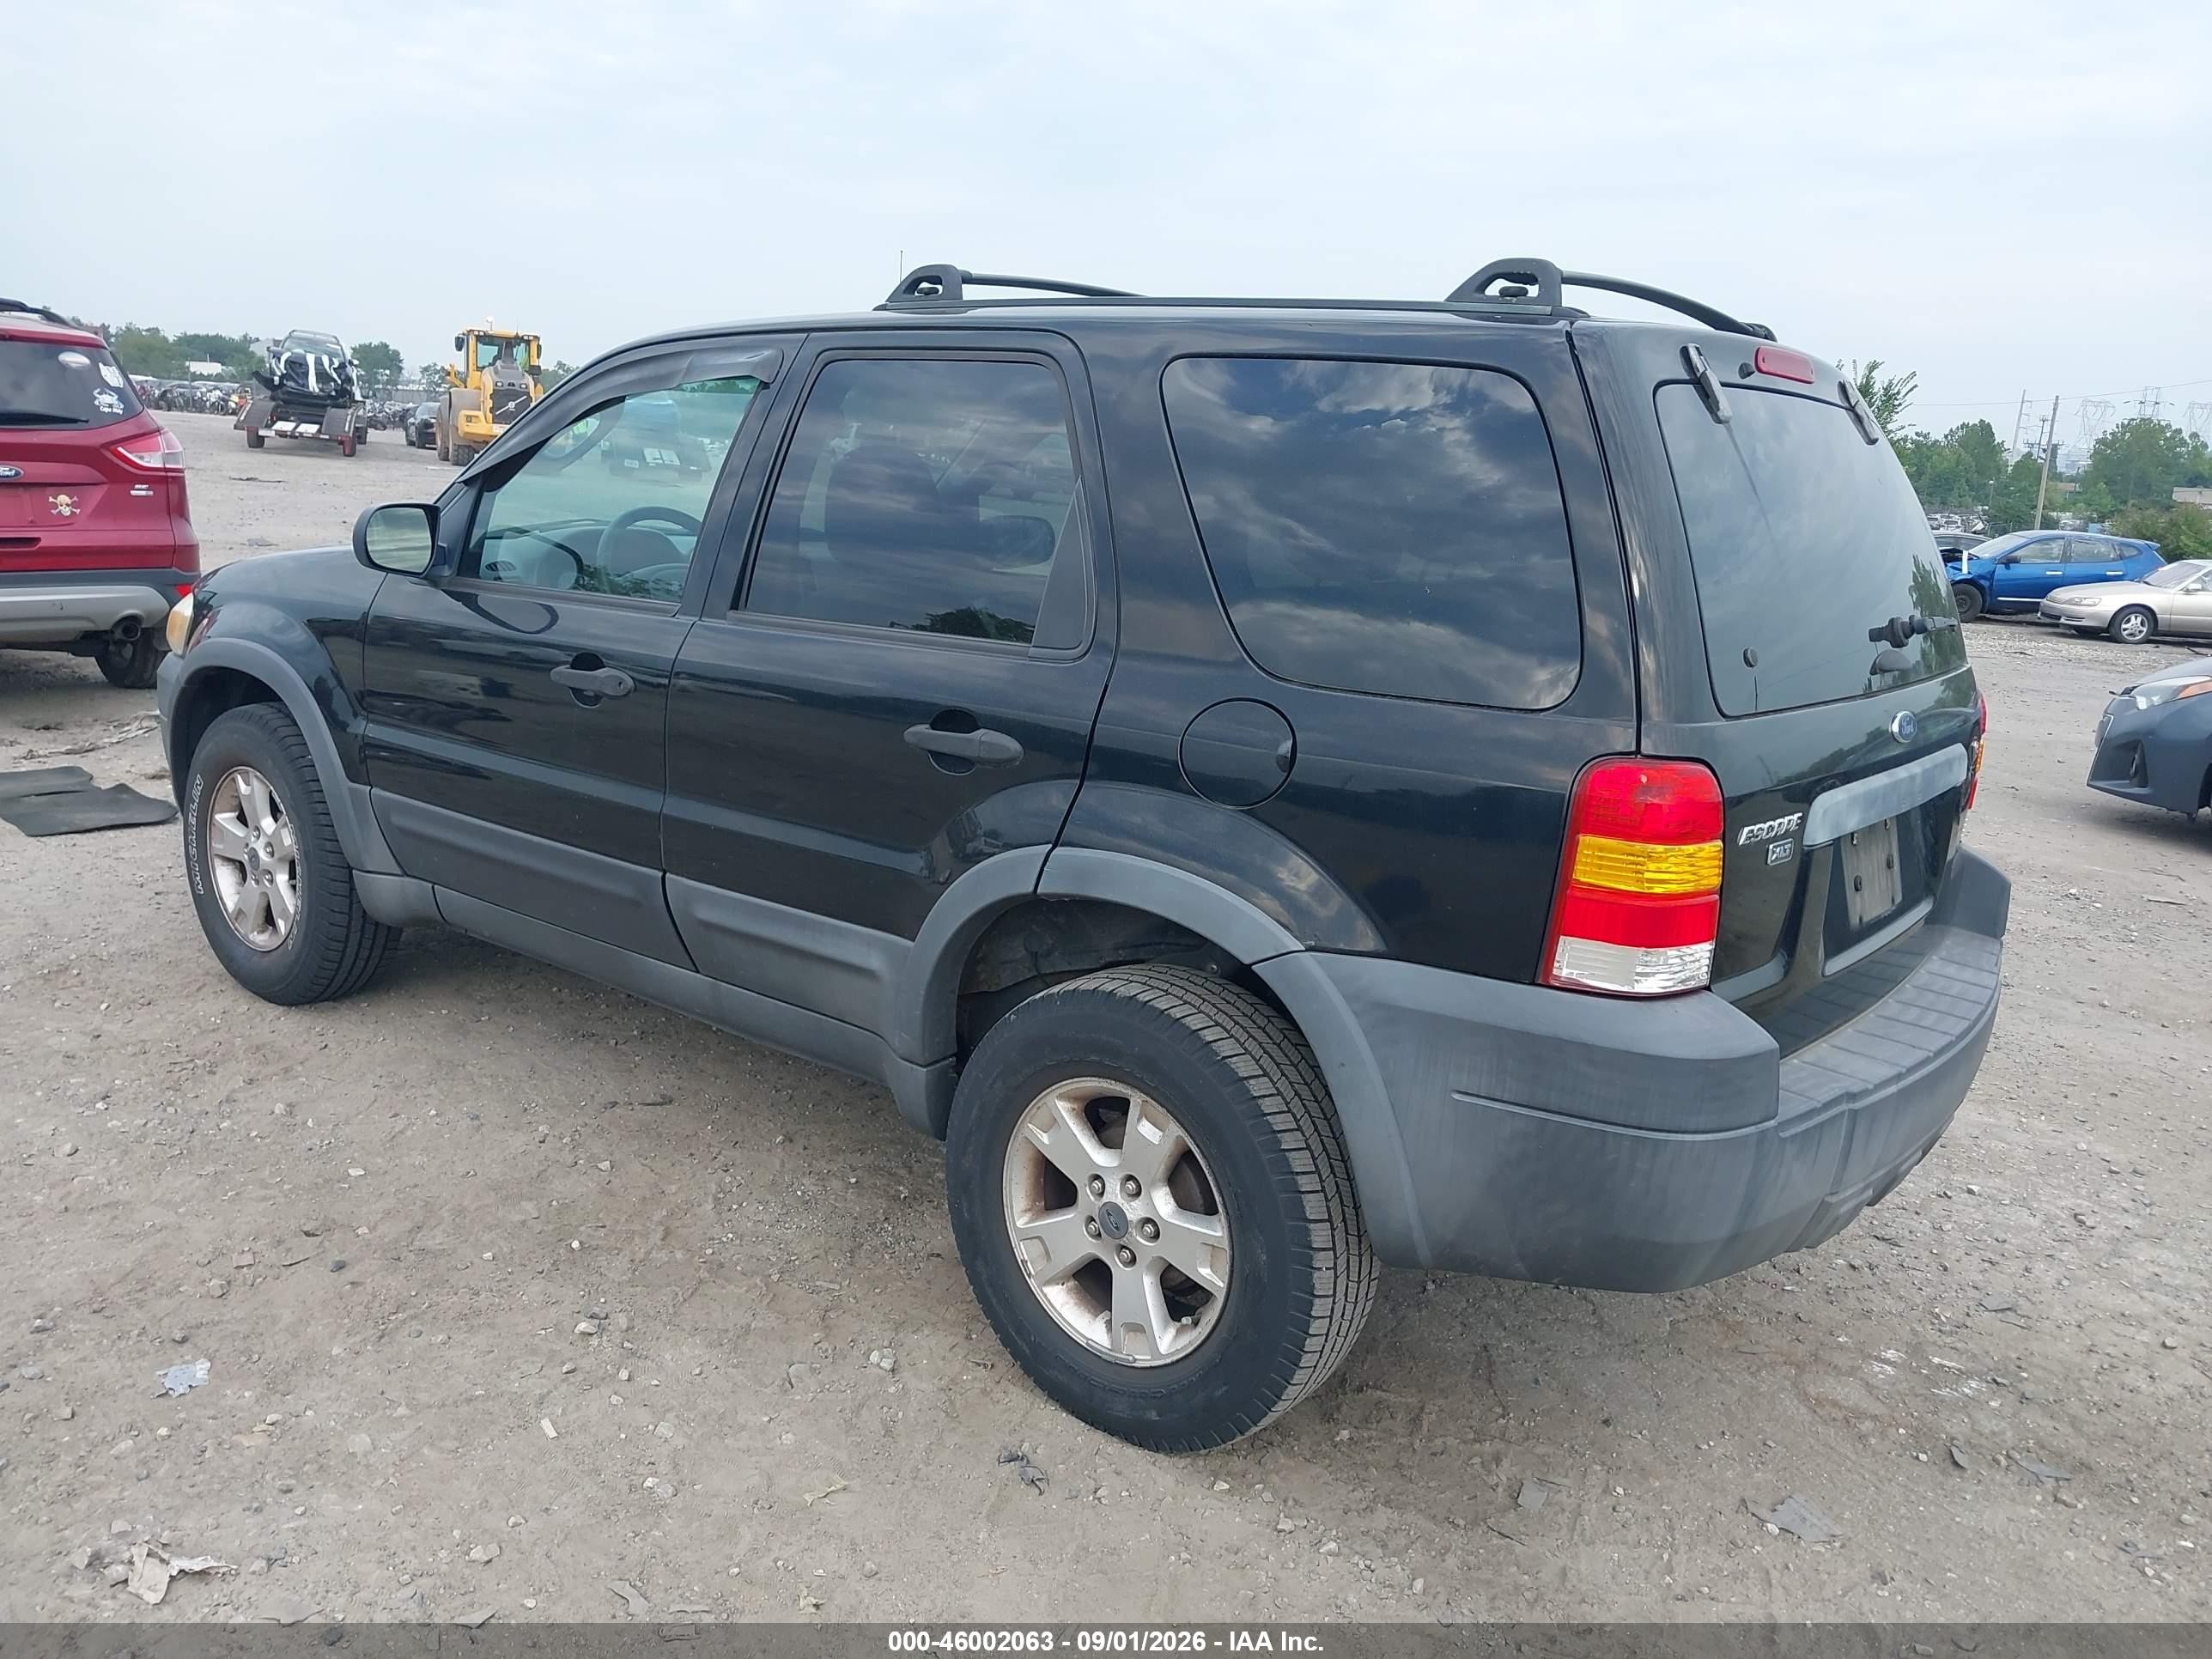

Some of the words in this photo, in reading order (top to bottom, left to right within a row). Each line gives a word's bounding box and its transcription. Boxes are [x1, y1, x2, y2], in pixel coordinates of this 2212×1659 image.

[100, 405, 112, 414] Cape
[186, 773, 205, 895] MICHELIN
[1737, 811, 1802, 846] ESCAPE
[1771, 842, 1792, 862] XLT
